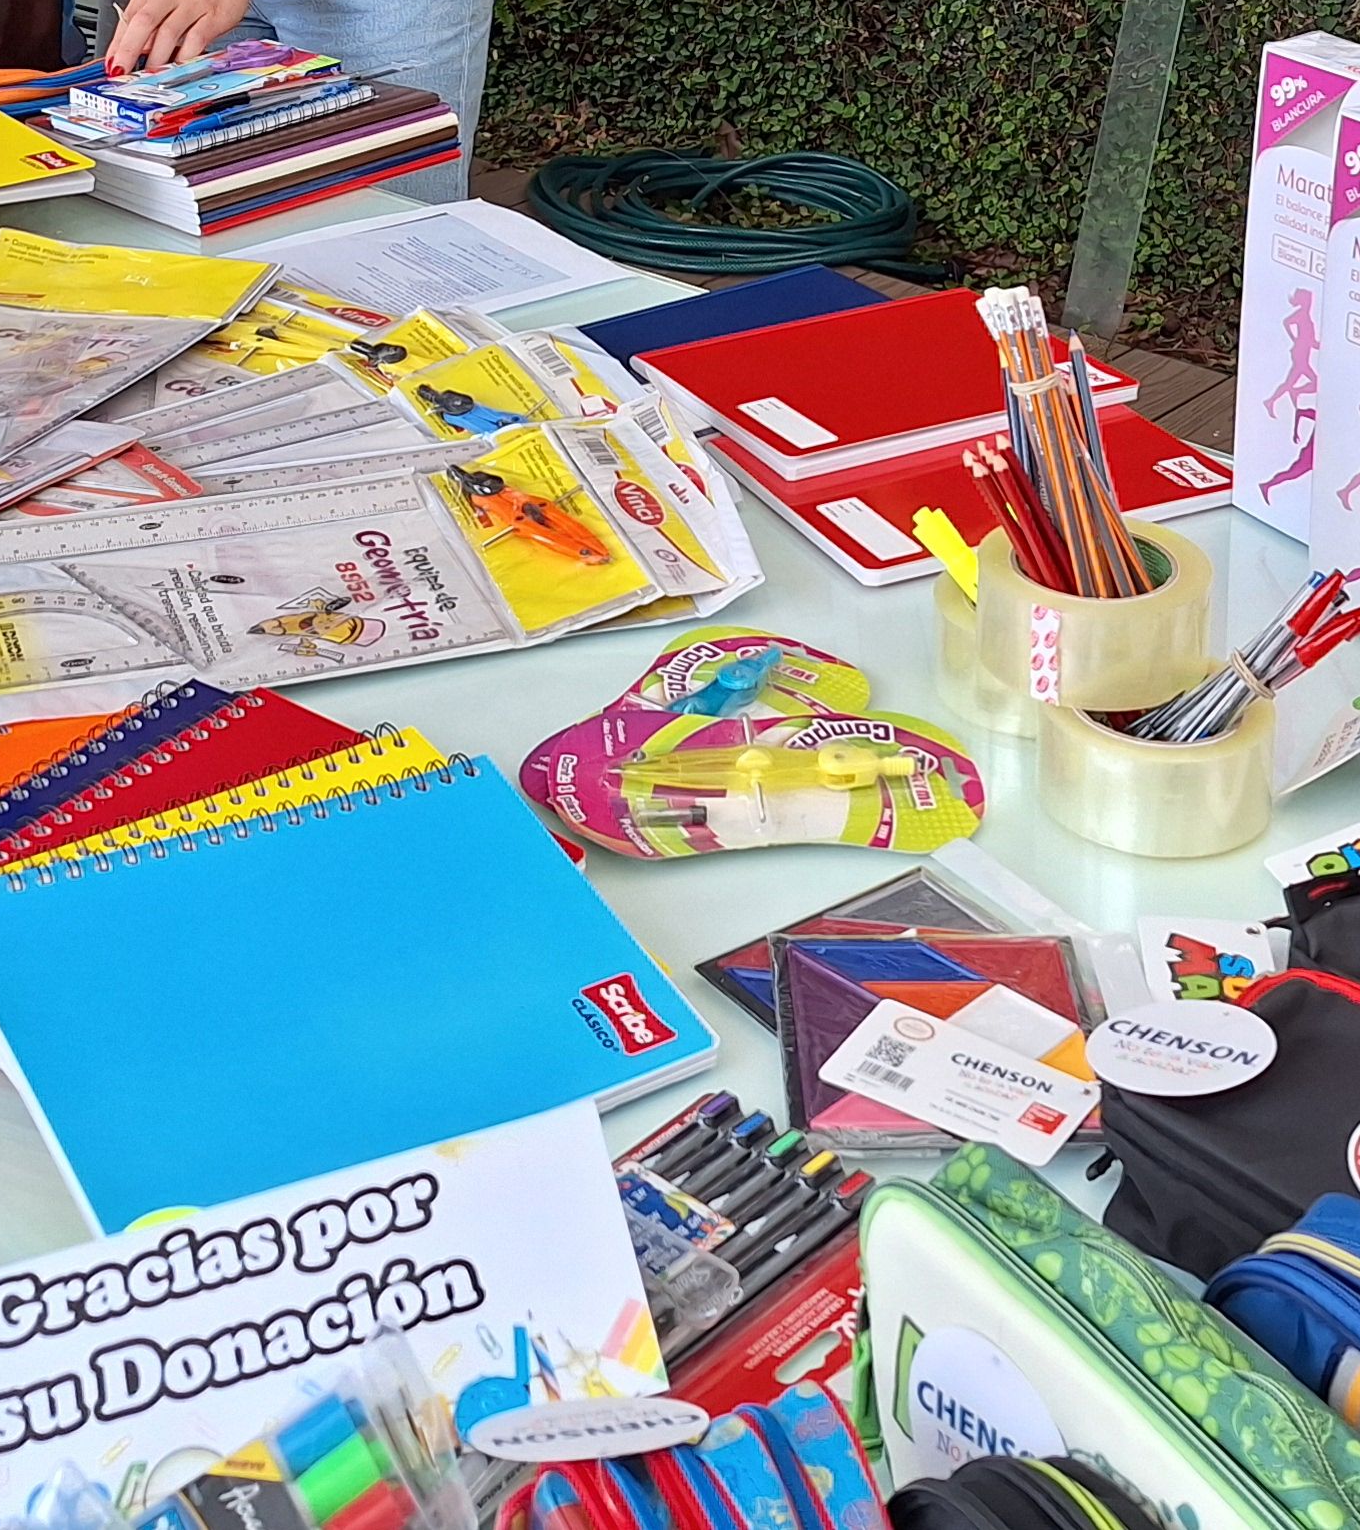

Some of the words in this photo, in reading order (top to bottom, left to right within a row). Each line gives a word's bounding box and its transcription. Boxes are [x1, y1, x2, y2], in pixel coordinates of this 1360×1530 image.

[1270, 75, 1308, 107] 99%
[1271, 89, 1326, 133] BLANCURA
[332, 305, 388, 329] Vinci
[1173, 459, 1214, 485] Scribe
[621, 483, 663, 525] Vinci
[334, 561, 376, 604] 8952
[353, 530, 443, 642] Geometría
[403, 545, 446, 592] Equipo
[202, 601, 218, 624] que
[660, 643, 723, 701] Compa
[571, 997, 616, 1051] CLÁSICO
[598, 981, 654, 1045] Scribe
[1108, 1019, 1259, 1066] CHENSON
[951, 1052, 1054, 1095] CHENSON
[287, 1170, 439, 1271] por
[94, 1258, 486, 1420] Donación
[492, 1408, 702, 1450] CHENSON
